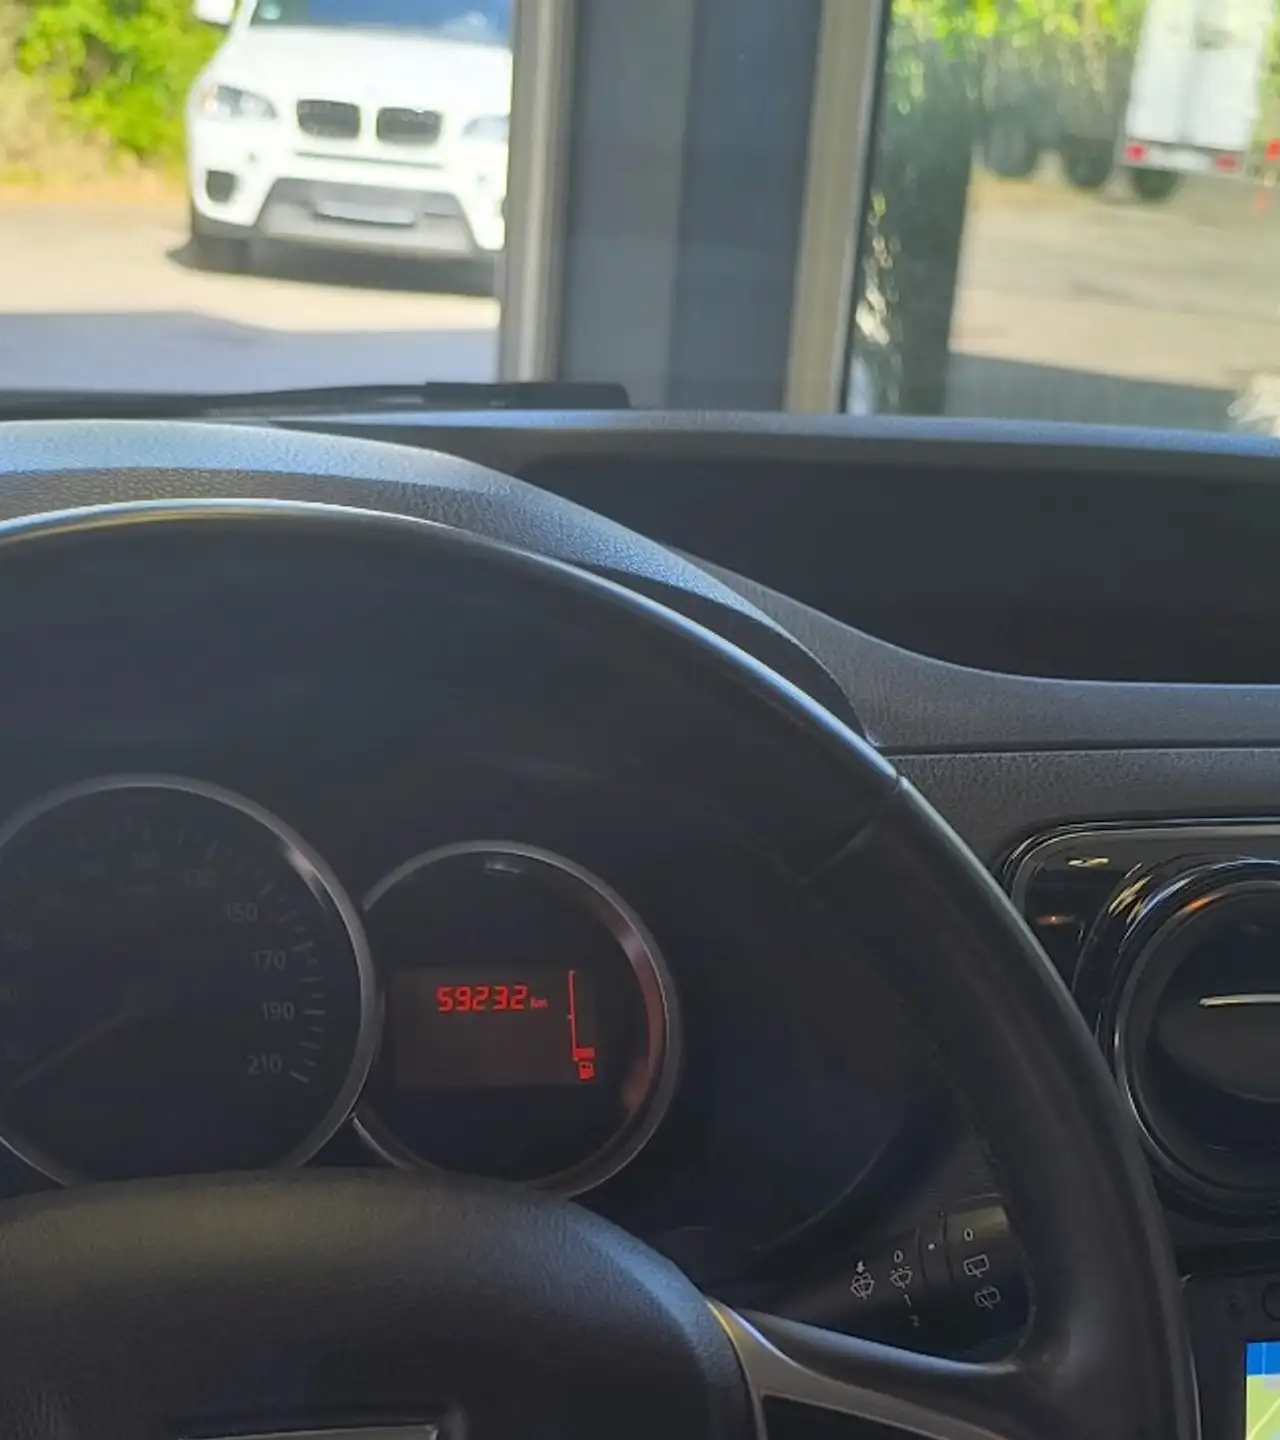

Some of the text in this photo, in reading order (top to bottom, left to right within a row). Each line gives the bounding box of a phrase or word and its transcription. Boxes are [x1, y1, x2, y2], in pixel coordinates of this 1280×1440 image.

[224, 902, 259, 923] 150
[252, 950, 287, 971] 170
[436, 984, 529, 1012] 59232
[261, 1001, 296, 1021] 190
[245, 1054, 283, 1076] 210
